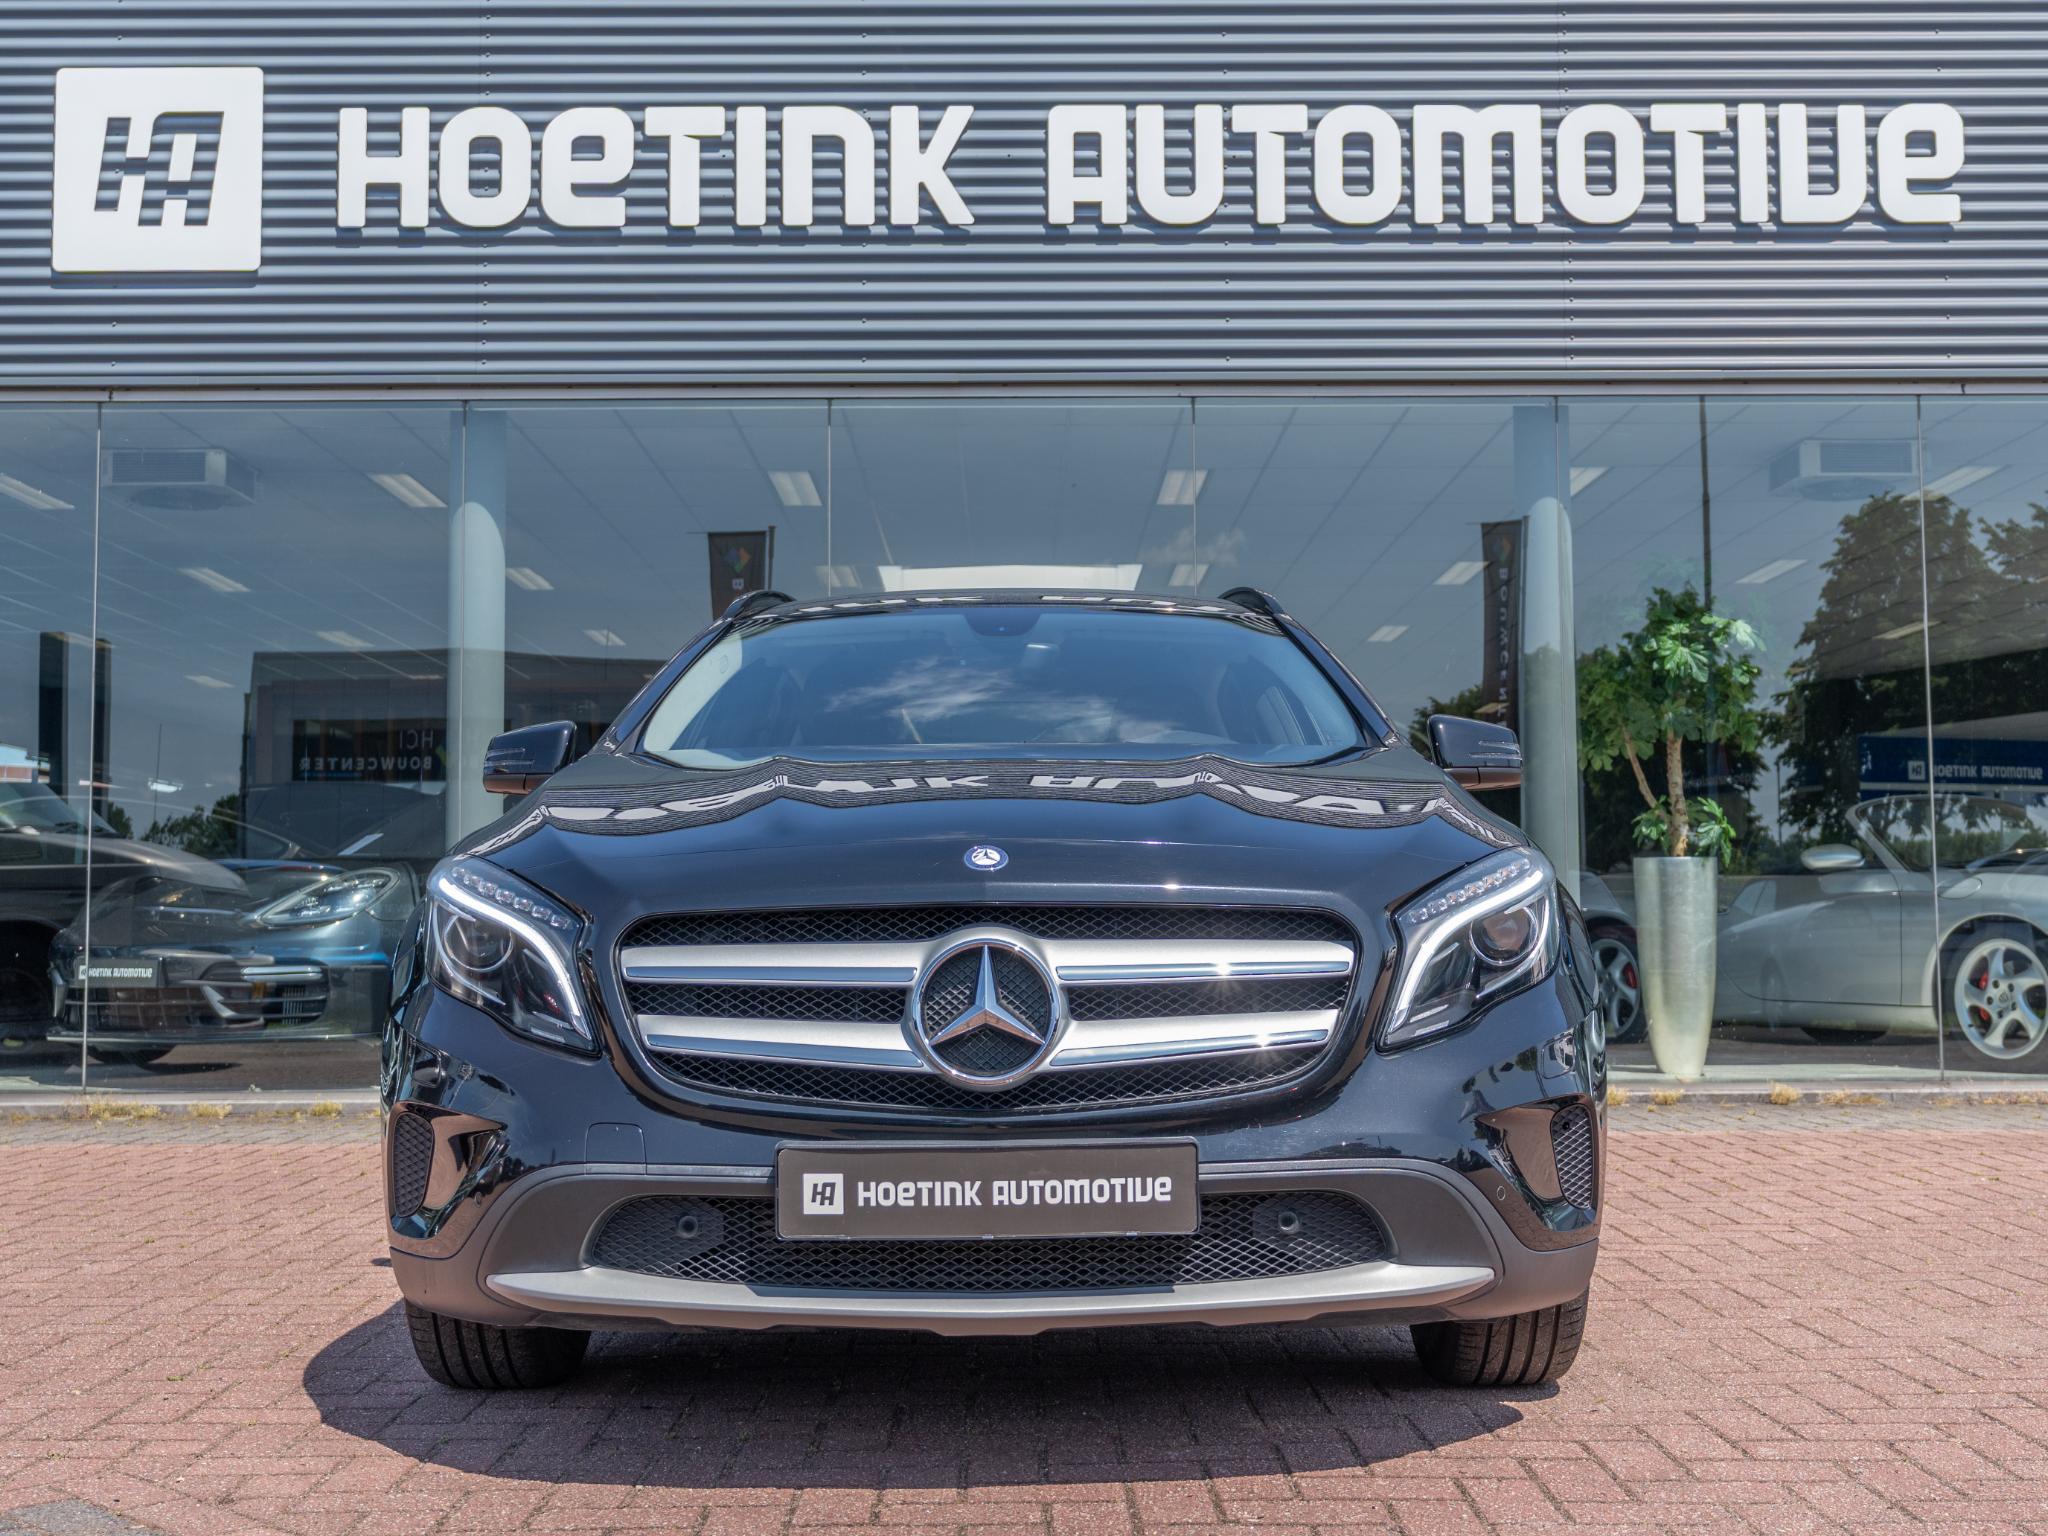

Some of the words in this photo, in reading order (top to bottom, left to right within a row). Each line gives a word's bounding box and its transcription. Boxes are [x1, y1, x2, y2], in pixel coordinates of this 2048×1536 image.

[337, 105, 975, 228] HOETINK
[1047, 102, 1965, 225] AUTOMOTIVE
[1982, 766, 2043, 780] AUTOMOTIVE
[113, 968, 152, 978] AUTOMOTIVE
[858, 1180, 982, 1207] HOETINK
[992, 1176, 1172, 1206] AUTOMOTIVE
